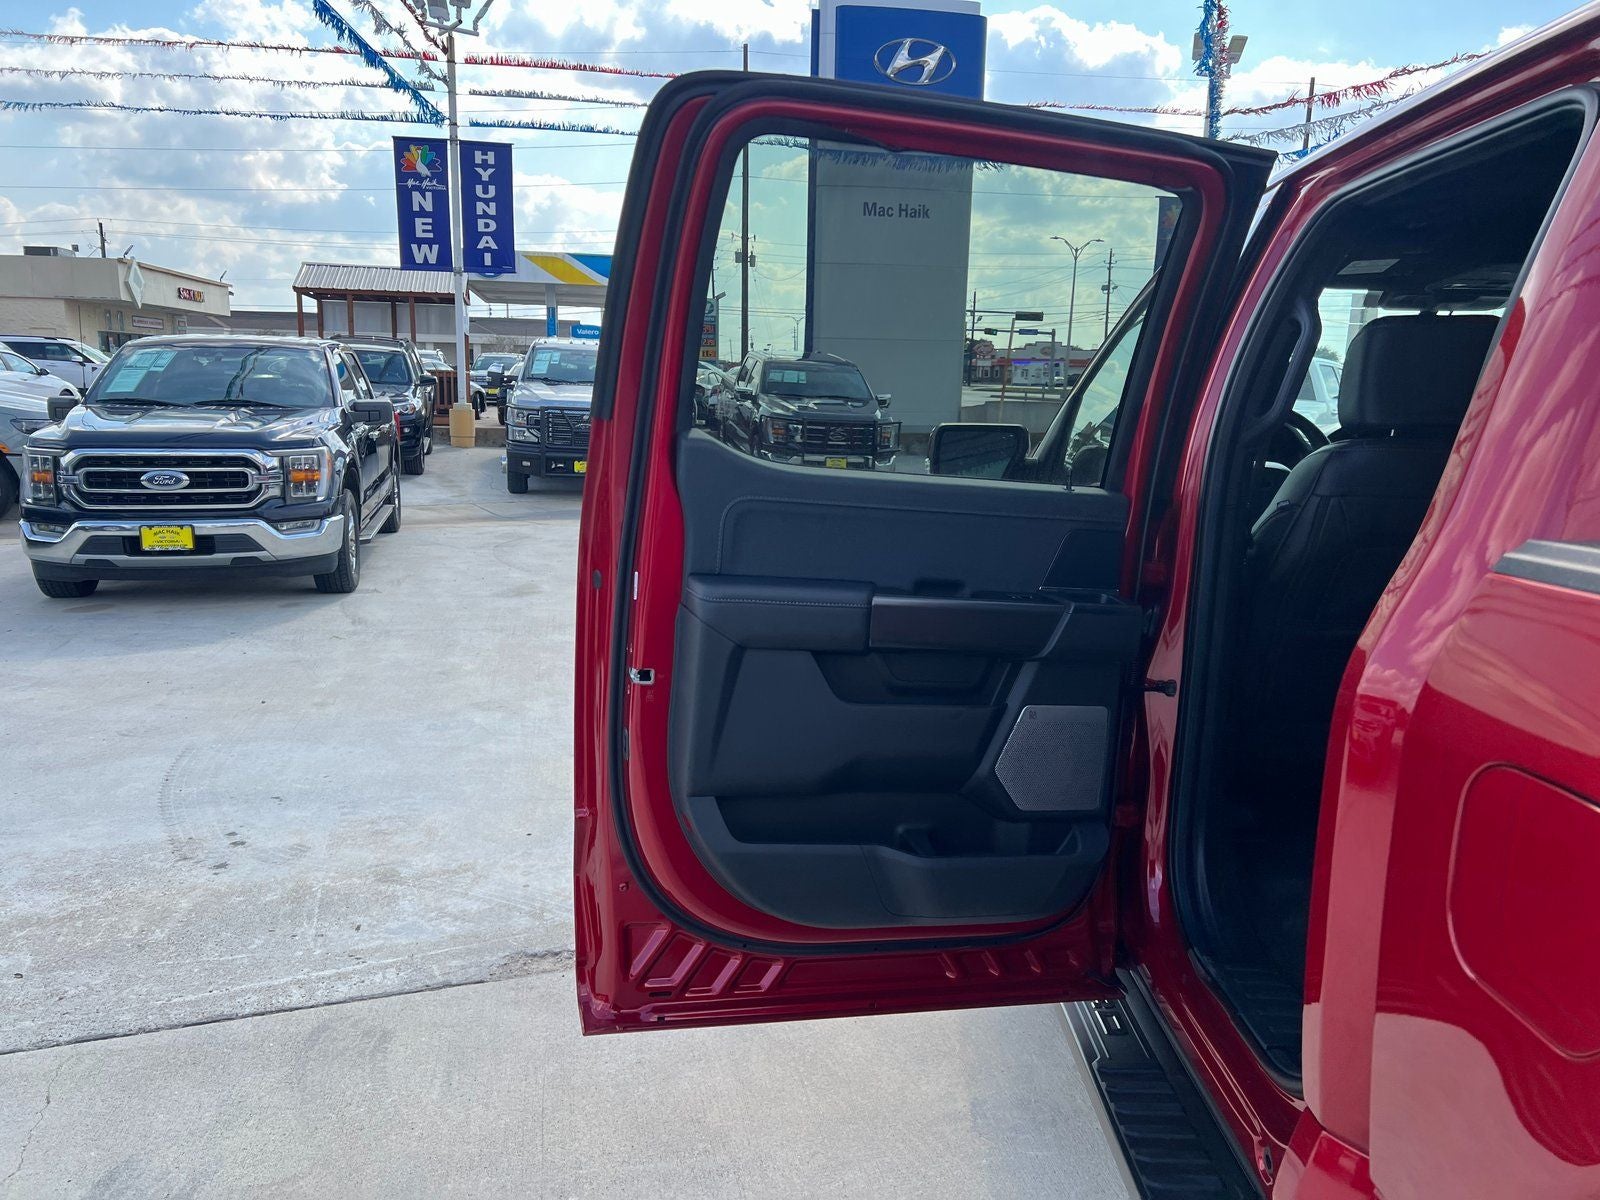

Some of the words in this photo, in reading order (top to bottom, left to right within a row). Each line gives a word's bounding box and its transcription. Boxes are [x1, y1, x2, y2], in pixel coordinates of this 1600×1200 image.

[411, 191, 439, 264] NEW
[474, 151, 498, 266] HYUNDAI
[863, 201, 894, 218] Mac
[898, 203, 930, 219] Haik
[152, 475, 176, 485] Ford
